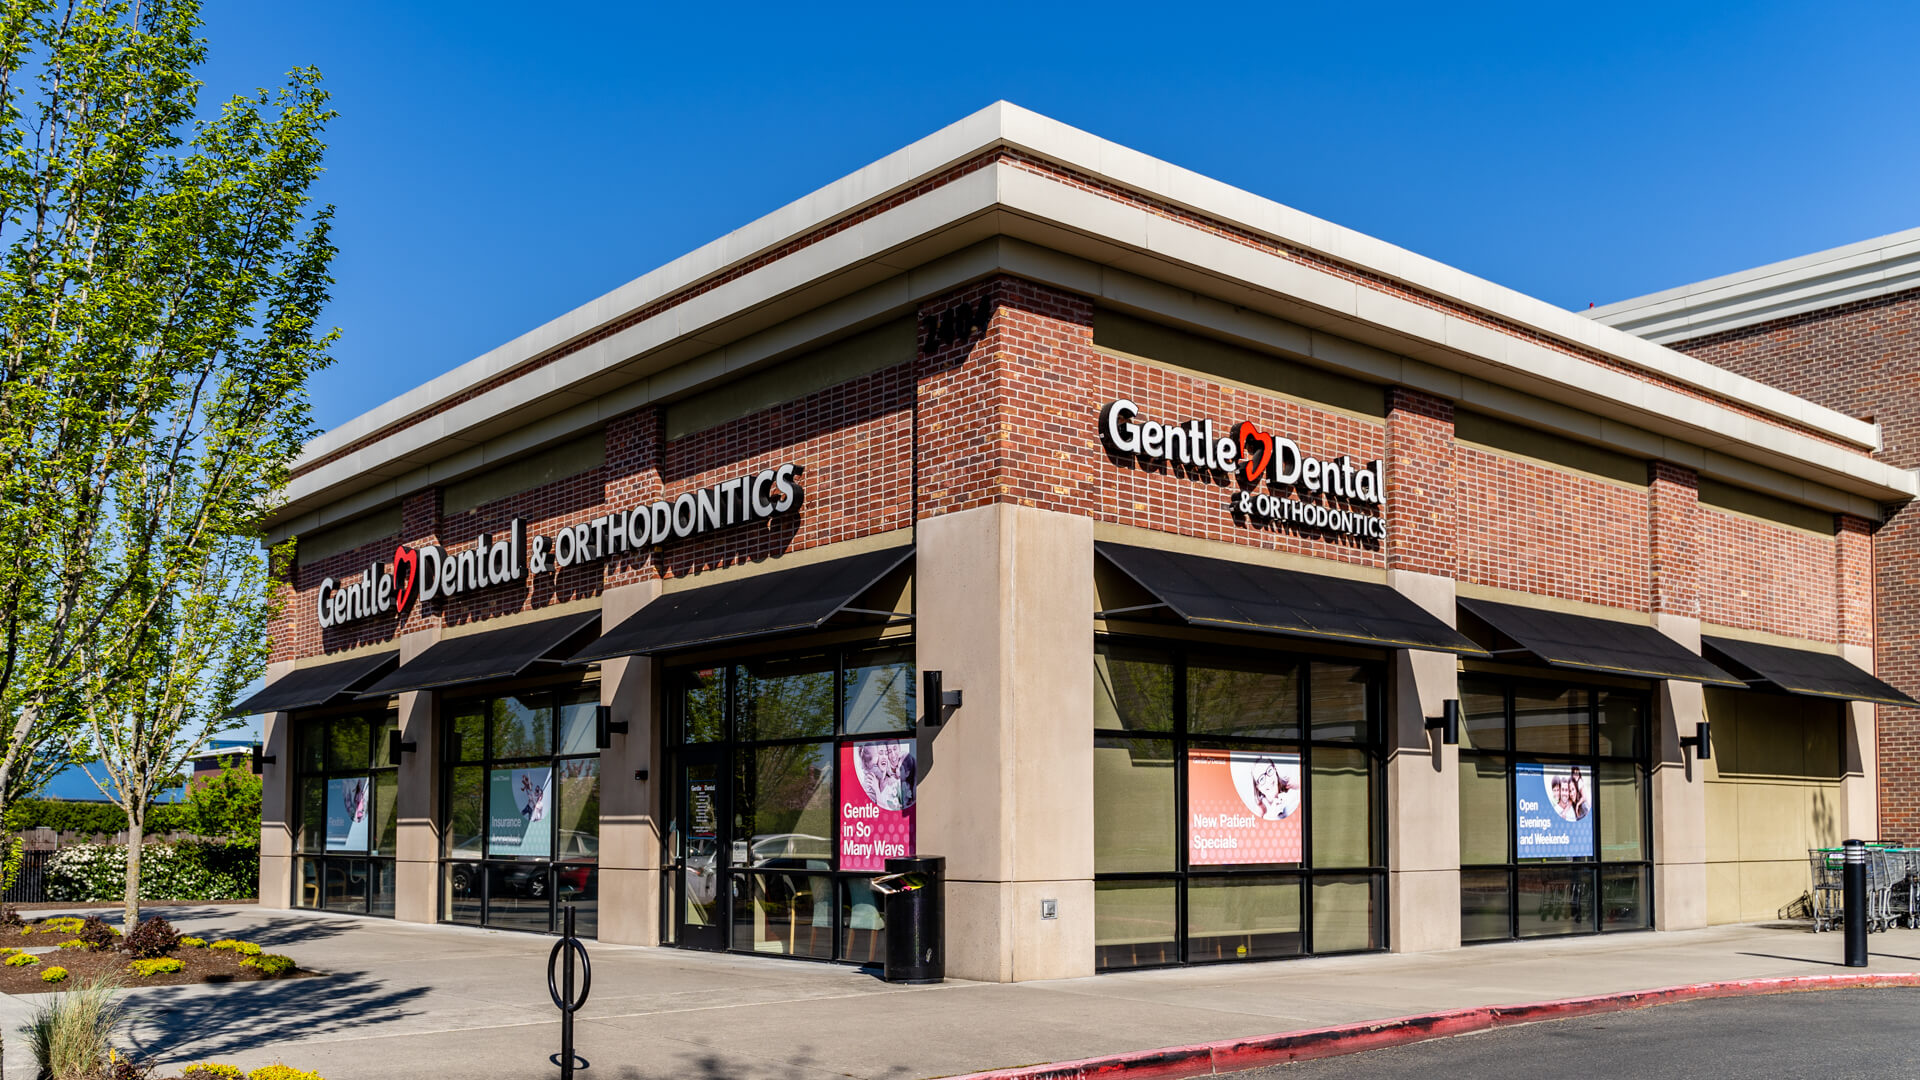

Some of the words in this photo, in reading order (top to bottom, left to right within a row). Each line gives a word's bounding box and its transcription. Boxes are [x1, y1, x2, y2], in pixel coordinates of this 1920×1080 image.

[1108, 398, 1238, 473] Gentle
[1274, 435, 1387, 505] Dental
[1239, 490, 1253, 515] &
[1256, 497, 1388, 540] ORTHODONTICS
[317, 562, 392, 629] Gentle
[418, 518, 523, 602] Dental
[530, 535, 549, 573] &
[554, 463, 799, 568] ORTHODONTICS
[843, 802, 880, 819] Gentle
[1519, 799, 1539, 813] Open
[491, 816, 522, 828] Insurance
[843, 822, 854, 838] in
[855, 821, 872, 838] So
[1193, 813, 1218, 828] New
[1219, 813, 1256, 829] Patient
[1519, 816, 1551, 830] Evenings
[1193, 834, 1238, 854] Specials
[1519, 833, 1534, 845] and
[1534, 832, 1570, 845] Weekends
[843, 839, 872, 859] Many
[874, 840, 905, 857] Ways
